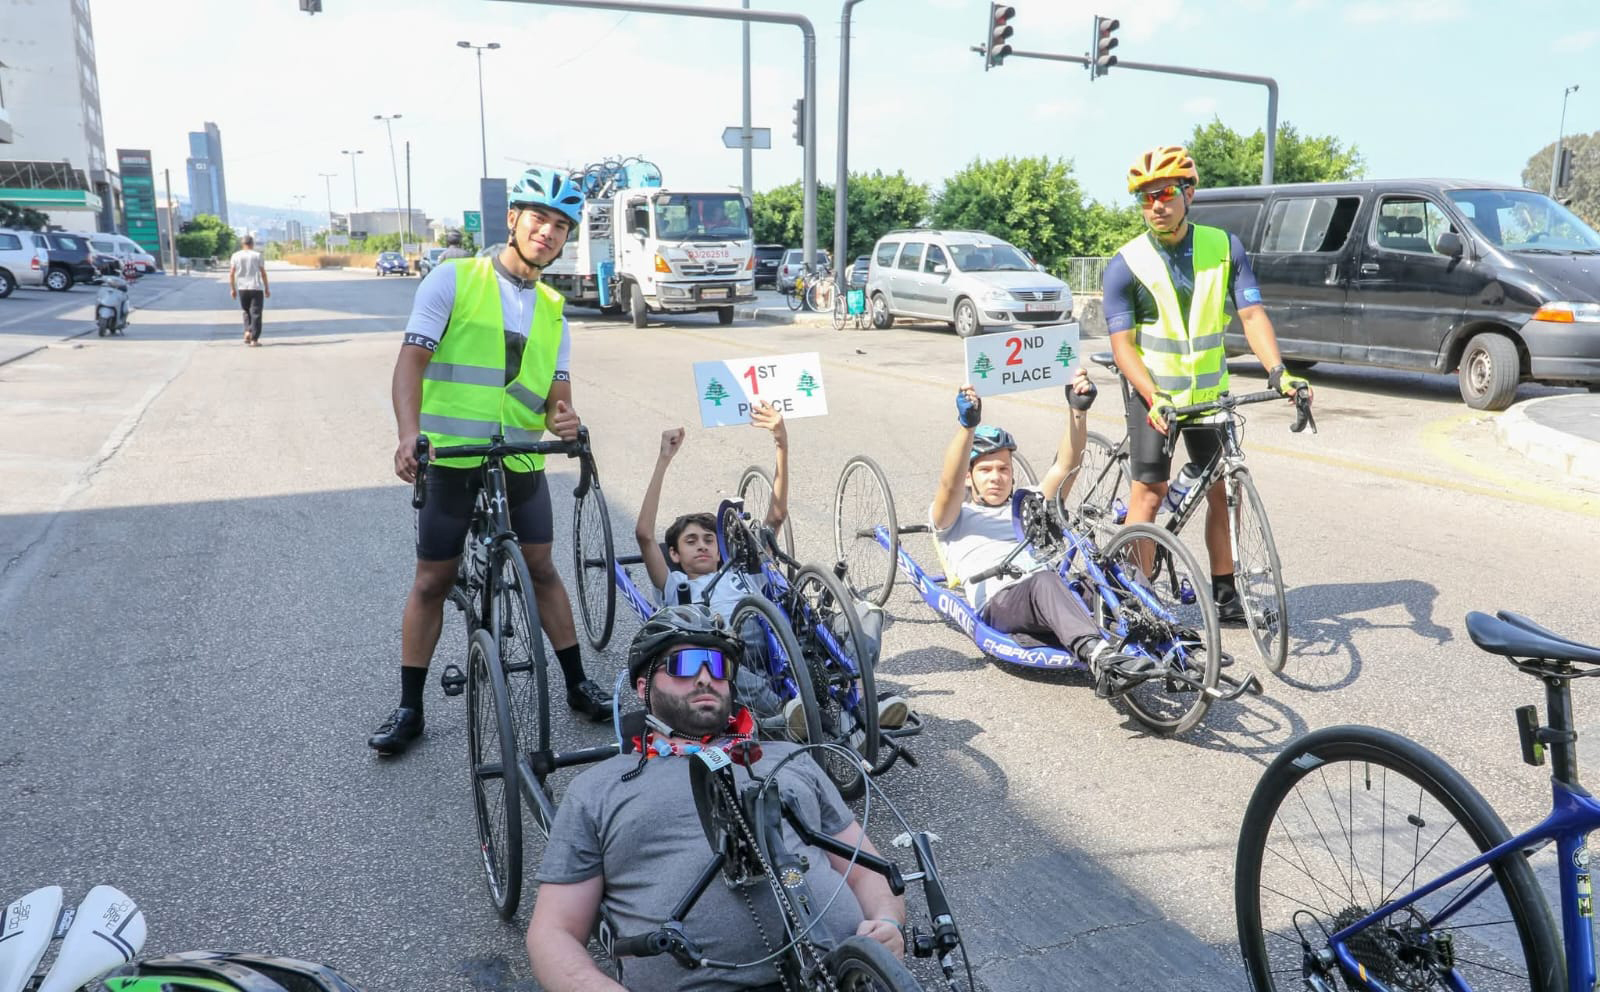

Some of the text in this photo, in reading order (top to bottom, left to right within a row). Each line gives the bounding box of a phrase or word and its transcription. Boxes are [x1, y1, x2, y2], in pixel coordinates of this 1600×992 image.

[1005, 336, 1044, 366] 2ND
[743, 365, 777, 395] 1ST
[1002, 366, 1052, 385] PLACE
[738, 398, 795, 417] PLCE
